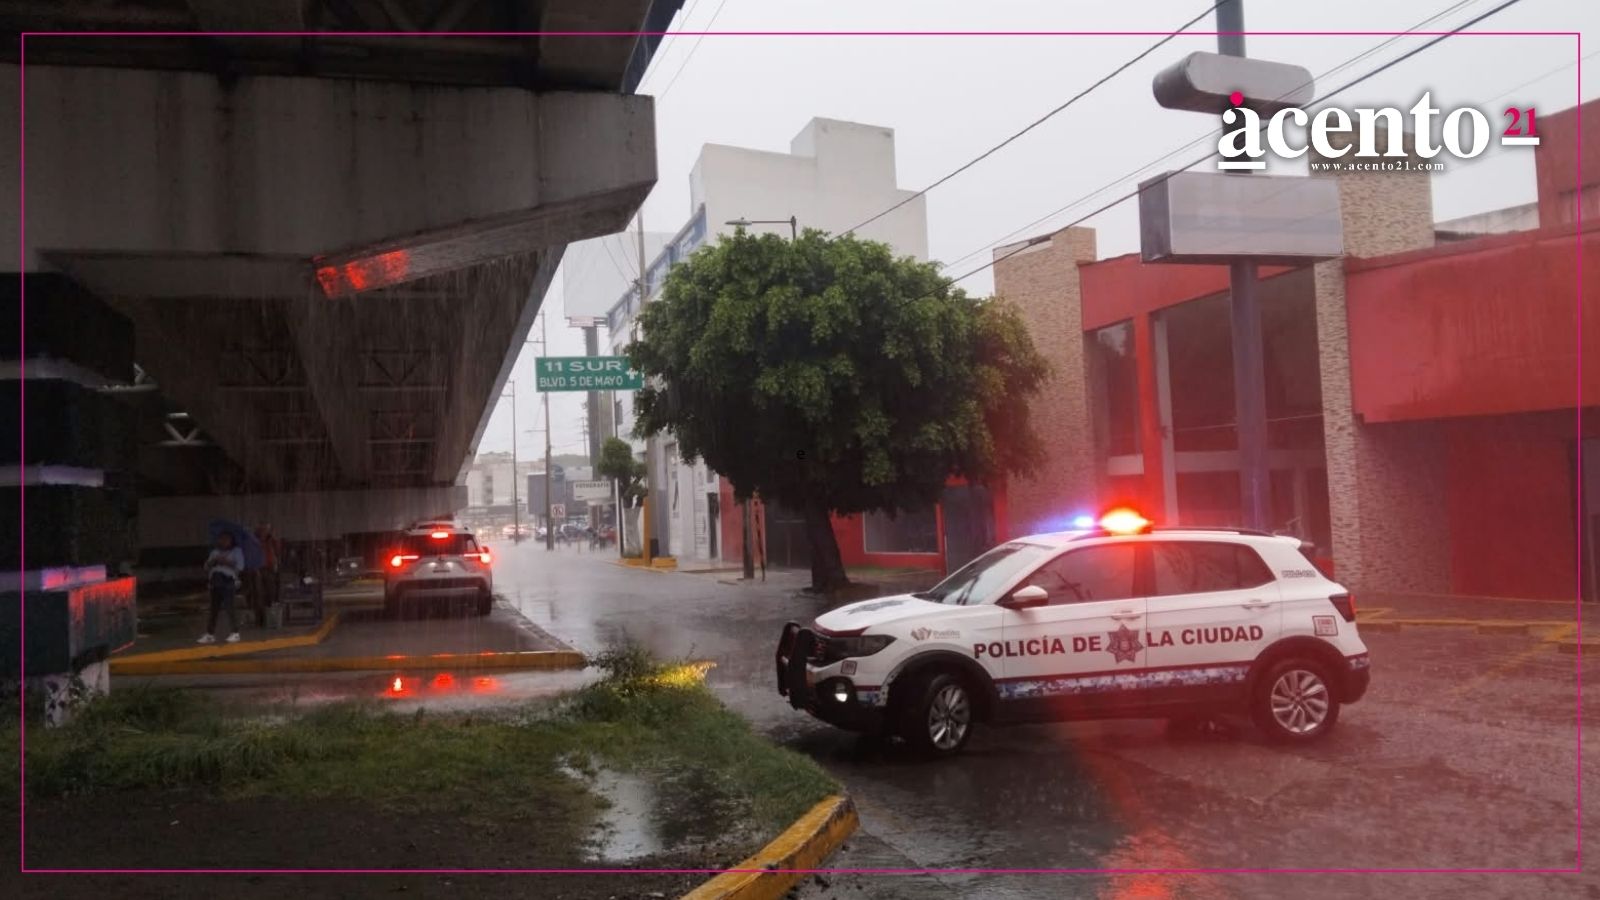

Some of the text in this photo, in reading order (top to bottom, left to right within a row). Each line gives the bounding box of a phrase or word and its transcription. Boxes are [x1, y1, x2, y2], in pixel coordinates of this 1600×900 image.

[544, 360, 622, 372] 11 SUR
[569, 377, 577, 387] 5
[579, 376, 594, 387] DE
[595, 375, 624, 387] MAYO
[973, 625, 1265, 659] POLICÍA DE LA CIUDAD
